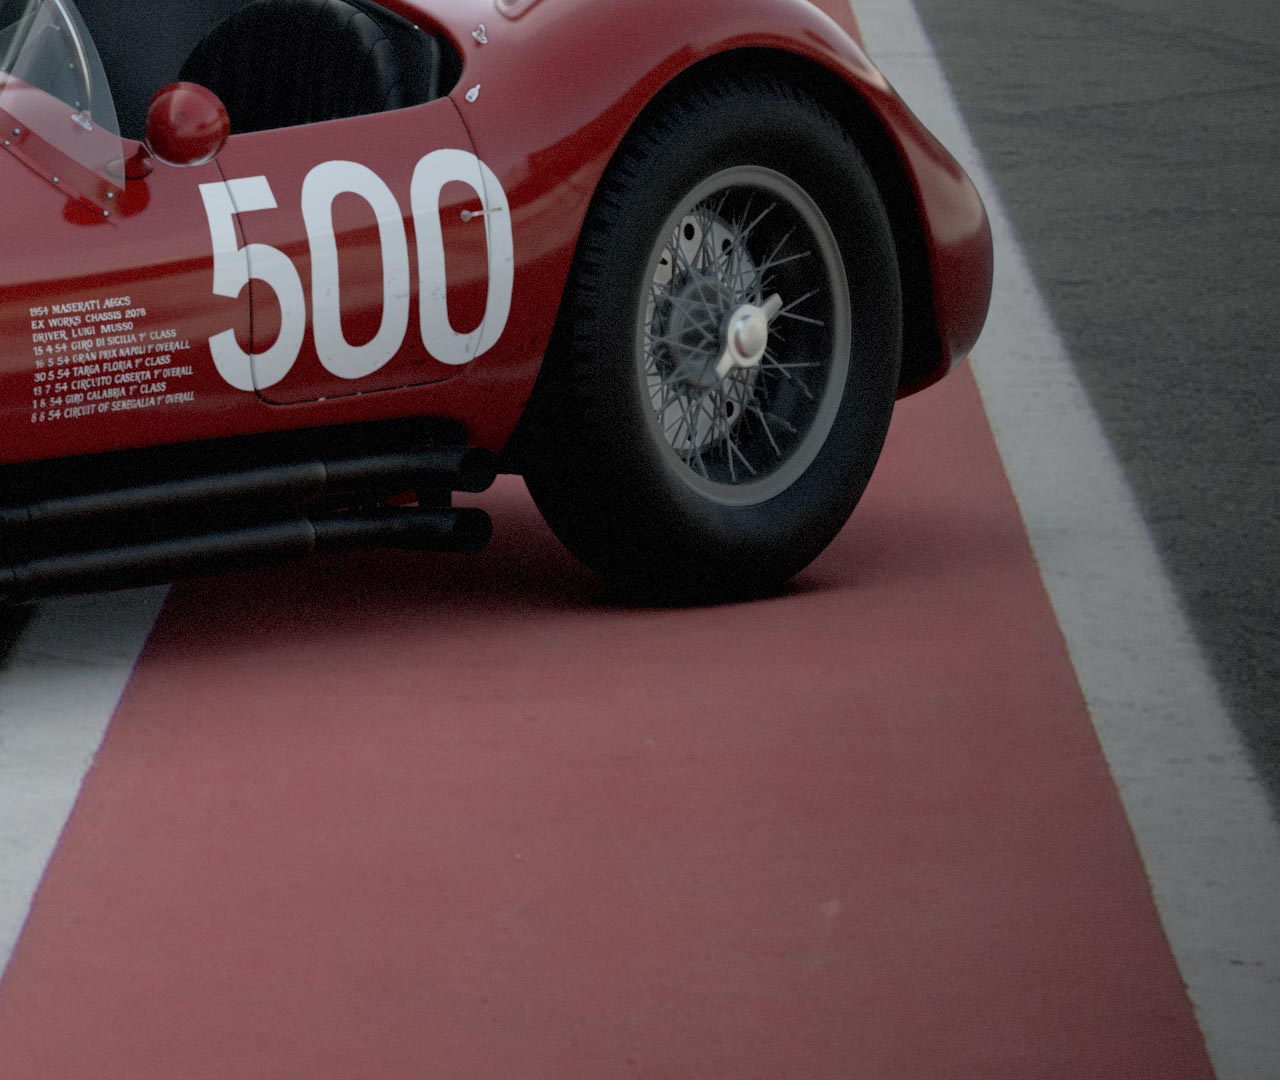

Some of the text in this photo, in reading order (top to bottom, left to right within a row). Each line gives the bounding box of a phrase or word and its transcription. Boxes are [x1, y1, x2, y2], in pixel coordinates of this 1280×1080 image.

[198, 148, 514, 391] 500
[30, 306, 49, 317] 1954
[51, 299, 100, 314] MASERATI
[31, 308, 146, 330] EX WORKS CHASSIS 2078
[32, 322, 134, 343] DRIVER LUIGI MUSSO
[33, 346, 44, 356] 15
[46, 344, 53, 354] 4
[55, 343, 68, 353] 54
[71, 339, 93, 351] GIRO
[96, 337, 105, 347] DI
[107, 333, 137, 345] SICILIA
[150, 329, 177, 340] CLASS
[47, 357, 54, 367] 5
[57, 355, 70, 366] 54
[72, 351, 96, 364] GRAN
[99, 348, 117, 360] PRIX
[119, 345, 146, 357] NAPOLI
[155, 339, 190, 352] OVERALL
[33, 372, 46, 382] 30
[47, 370, 55, 380] 5
[57, 368, 70, 379] 54
[72, 364, 100, 377] TARGA
[103, 360, 132, 372] FLORIA
[145, 354, 171, 367] CLASS
[45, 384, 51, 394] 7
[54, 382, 68, 393] 54
[71, 375, 112, 390] CIRCUITO
[114, 370, 151, 383] CASERTA
[162, 366, 193, 378] OVERALL
[48, 409, 61, 420] 54
[63, 404, 96, 418] CIRCUIT
[98, 402, 110, 413] OF
[111, 396, 155, 411] SENEGALIA
[165, 391, 195, 404] OVERALL
[50, 396, 62, 407] 54
[65, 393, 84, 404] GIRO
[87, 386, 126, 401] CALABRIA
[140, 381, 167, 394] CLASS
